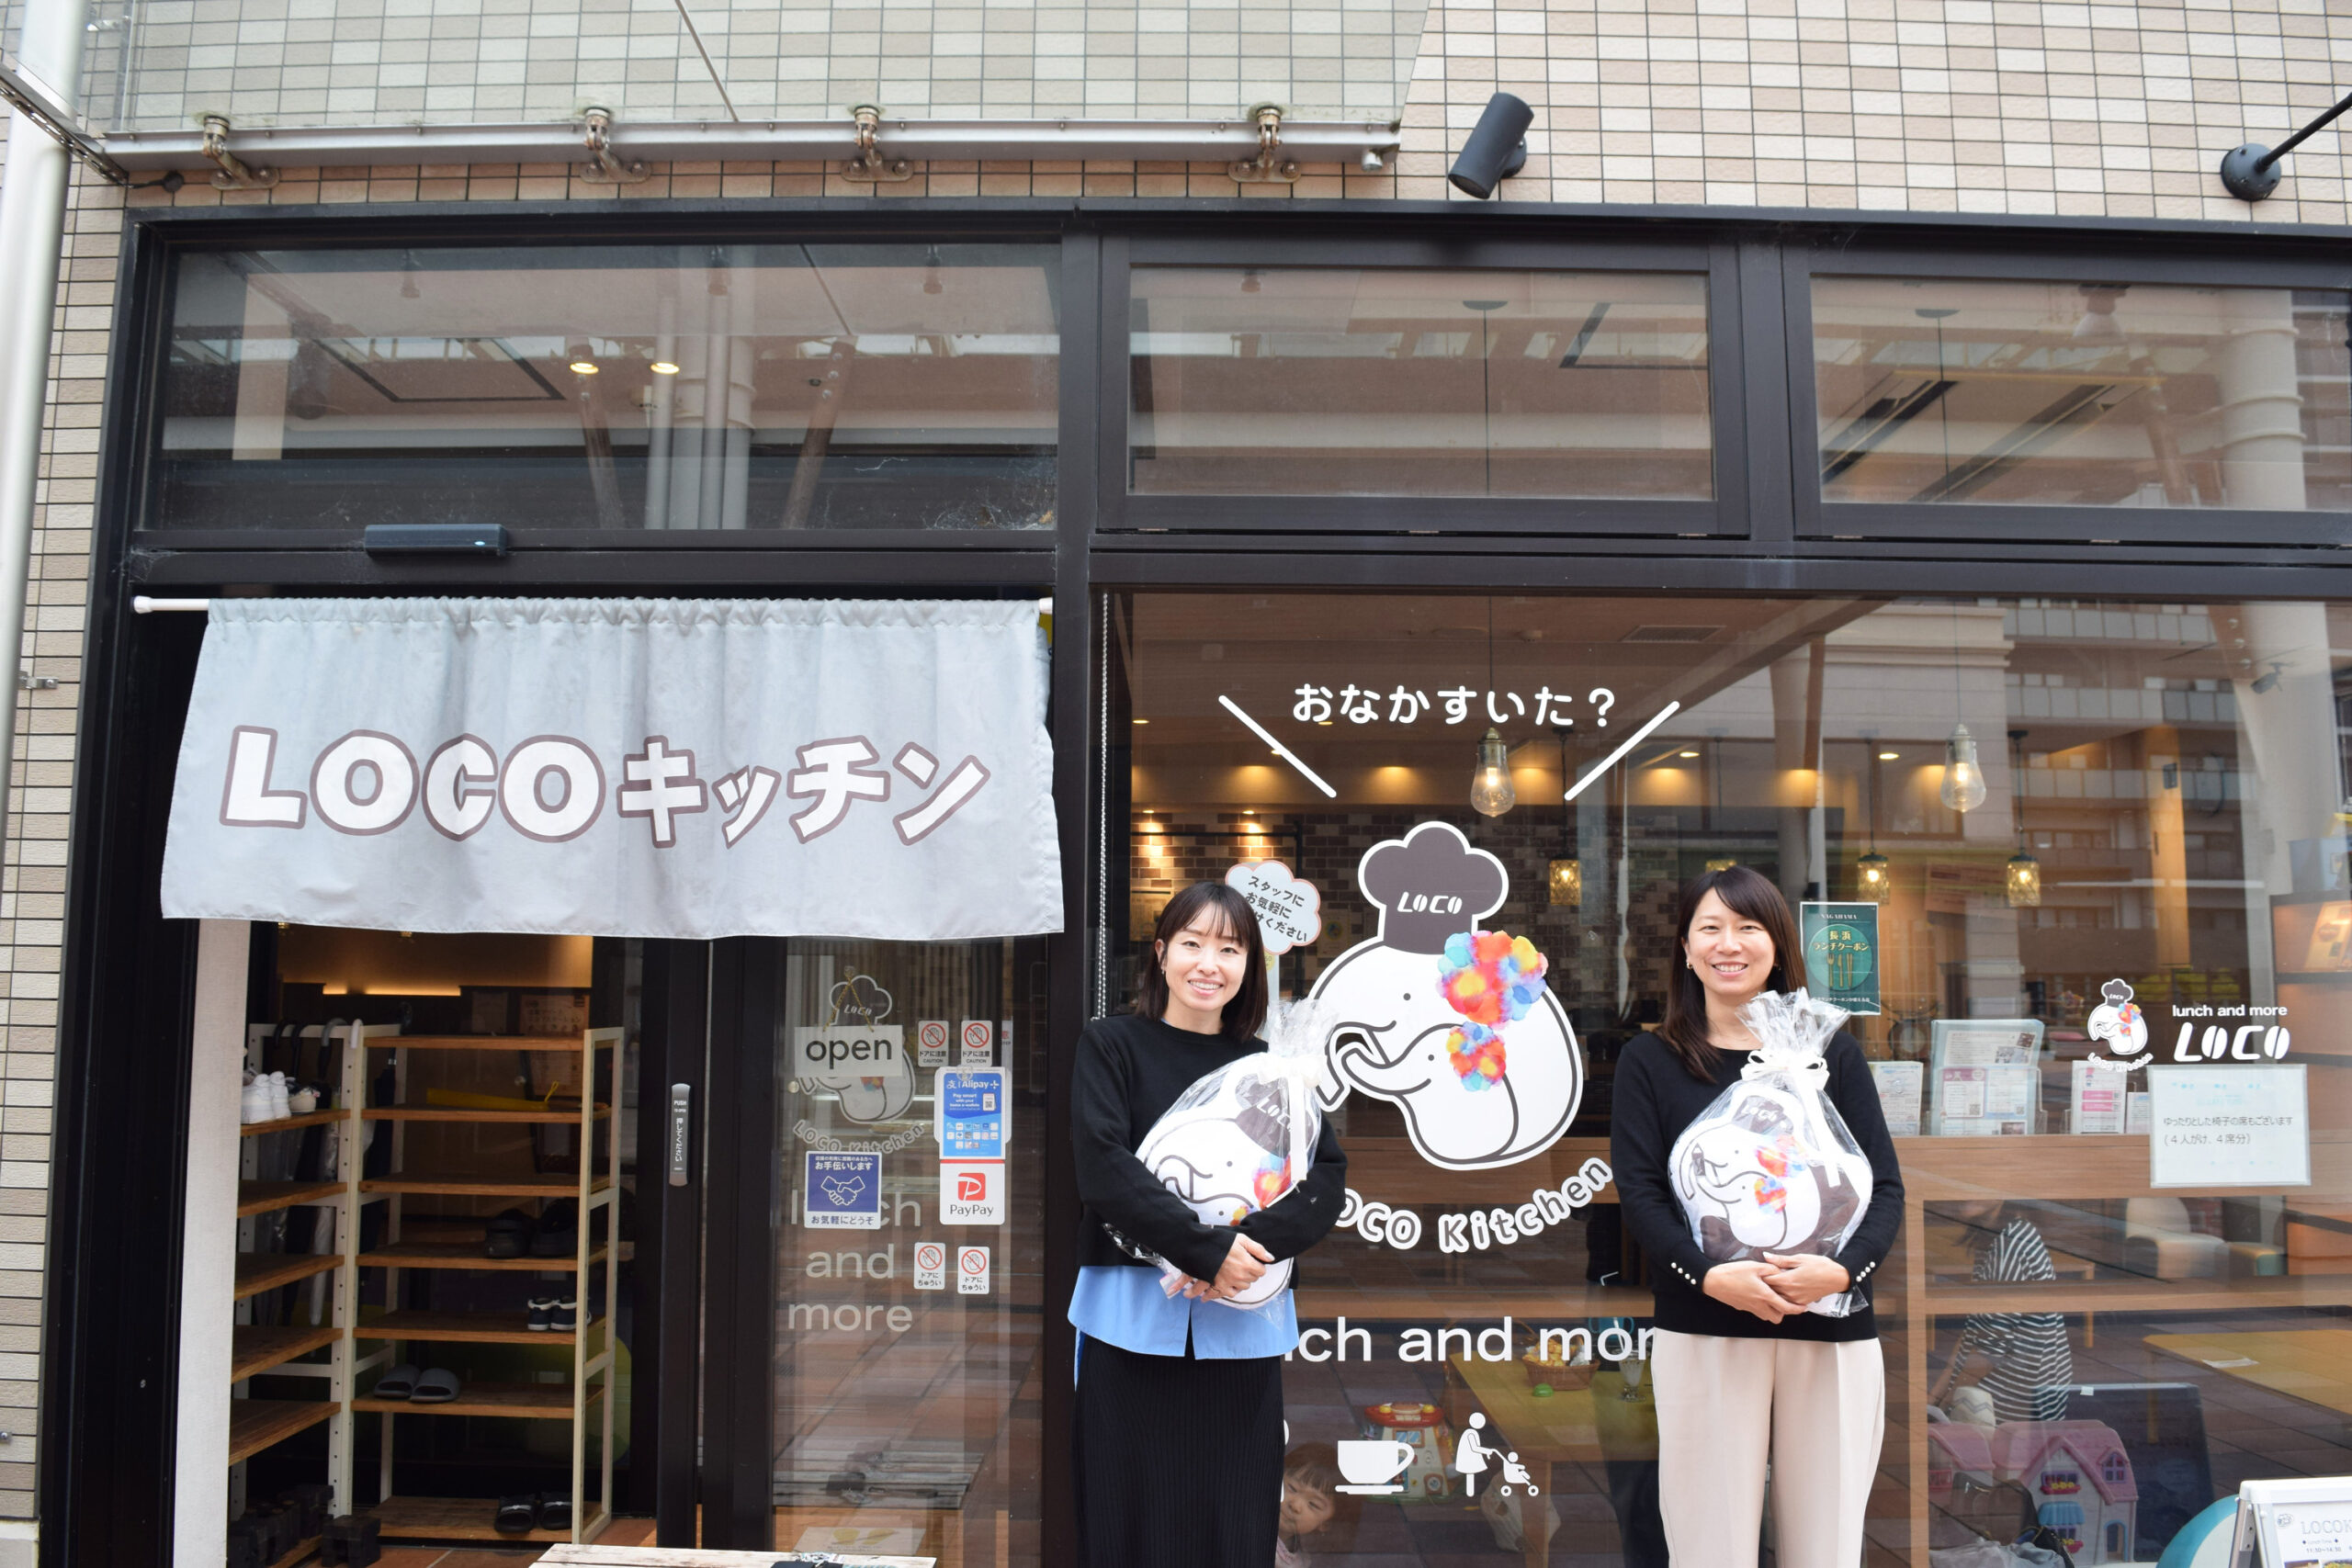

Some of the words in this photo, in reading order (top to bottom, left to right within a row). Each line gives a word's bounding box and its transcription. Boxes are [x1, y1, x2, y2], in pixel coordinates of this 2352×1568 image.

[1293, 682, 1615, 727] おなかすいた？
[219, 725, 991, 849] LOCOキッチン
[1246, 892, 1292, 919] お気軽に
[1248, 875, 1305, 907] スタッフに
[1397, 891, 1463, 914] LOCO
[1254, 911, 1307, 942] けください
[1829, 931, 1851, 941] 長浜
[1813, 942, 1870, 952] ランチクーポン
[2172, 1004, 2213, 1017] lunch
[2217, 1004, 2245, 1017] and
[2249, 1005, 2288, 1016] more
[806, 1039, 892, 1070] open
[2174, 1021, 2290, 1062] LOCO
[1256, 1097, 1292, 1132] LOC
[2164, 1116, 2293, 1126] ゆったりとした椅子の席もございます
[793, 1119, 842, 1152] LOCO
[849, 1123, 925, 1154] Kitchen
[815, 1161, 873, 1170] お手伝いします
[811, 1215, 875, 1225] お気軽にどうぞ
[949, 1204, 993, 1217] PayPay
[1335, 1188, 1422, 1249] OCO
[1438, 1156, 1613, 1253] Kitchen
[806, 1243, 895, 1280] and
[788, 1303, 913, 1332] more
[1284, 1315, 1372, 1362] ch
[1398, 1315, 1513, 1362] and
[1540, 1326, 1655, 1362] mor
